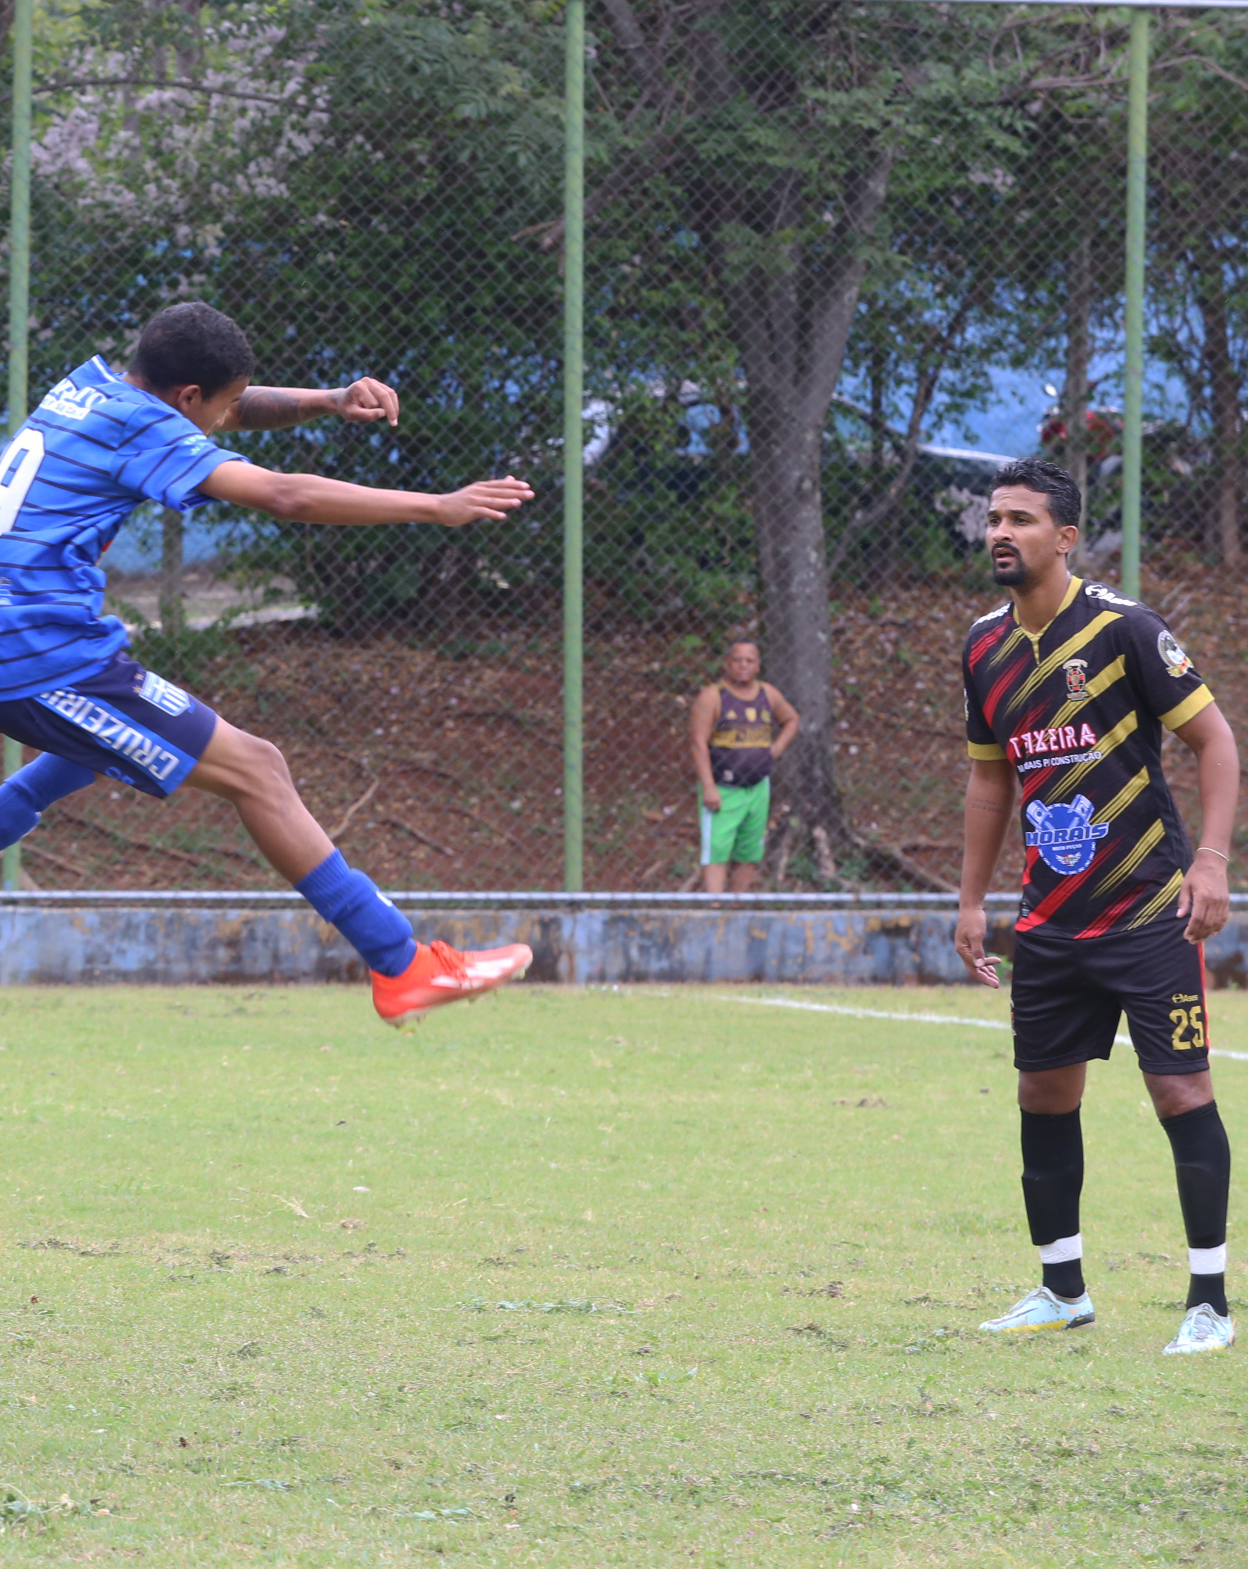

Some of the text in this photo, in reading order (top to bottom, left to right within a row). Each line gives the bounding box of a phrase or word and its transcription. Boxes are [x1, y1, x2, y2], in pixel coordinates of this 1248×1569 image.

[1051, 751, 1103, 767] CONSTRUÇÃO
[1025, 821, 1110, 847] MORAIS
[1168, 1005, 1205, 1051] 25
